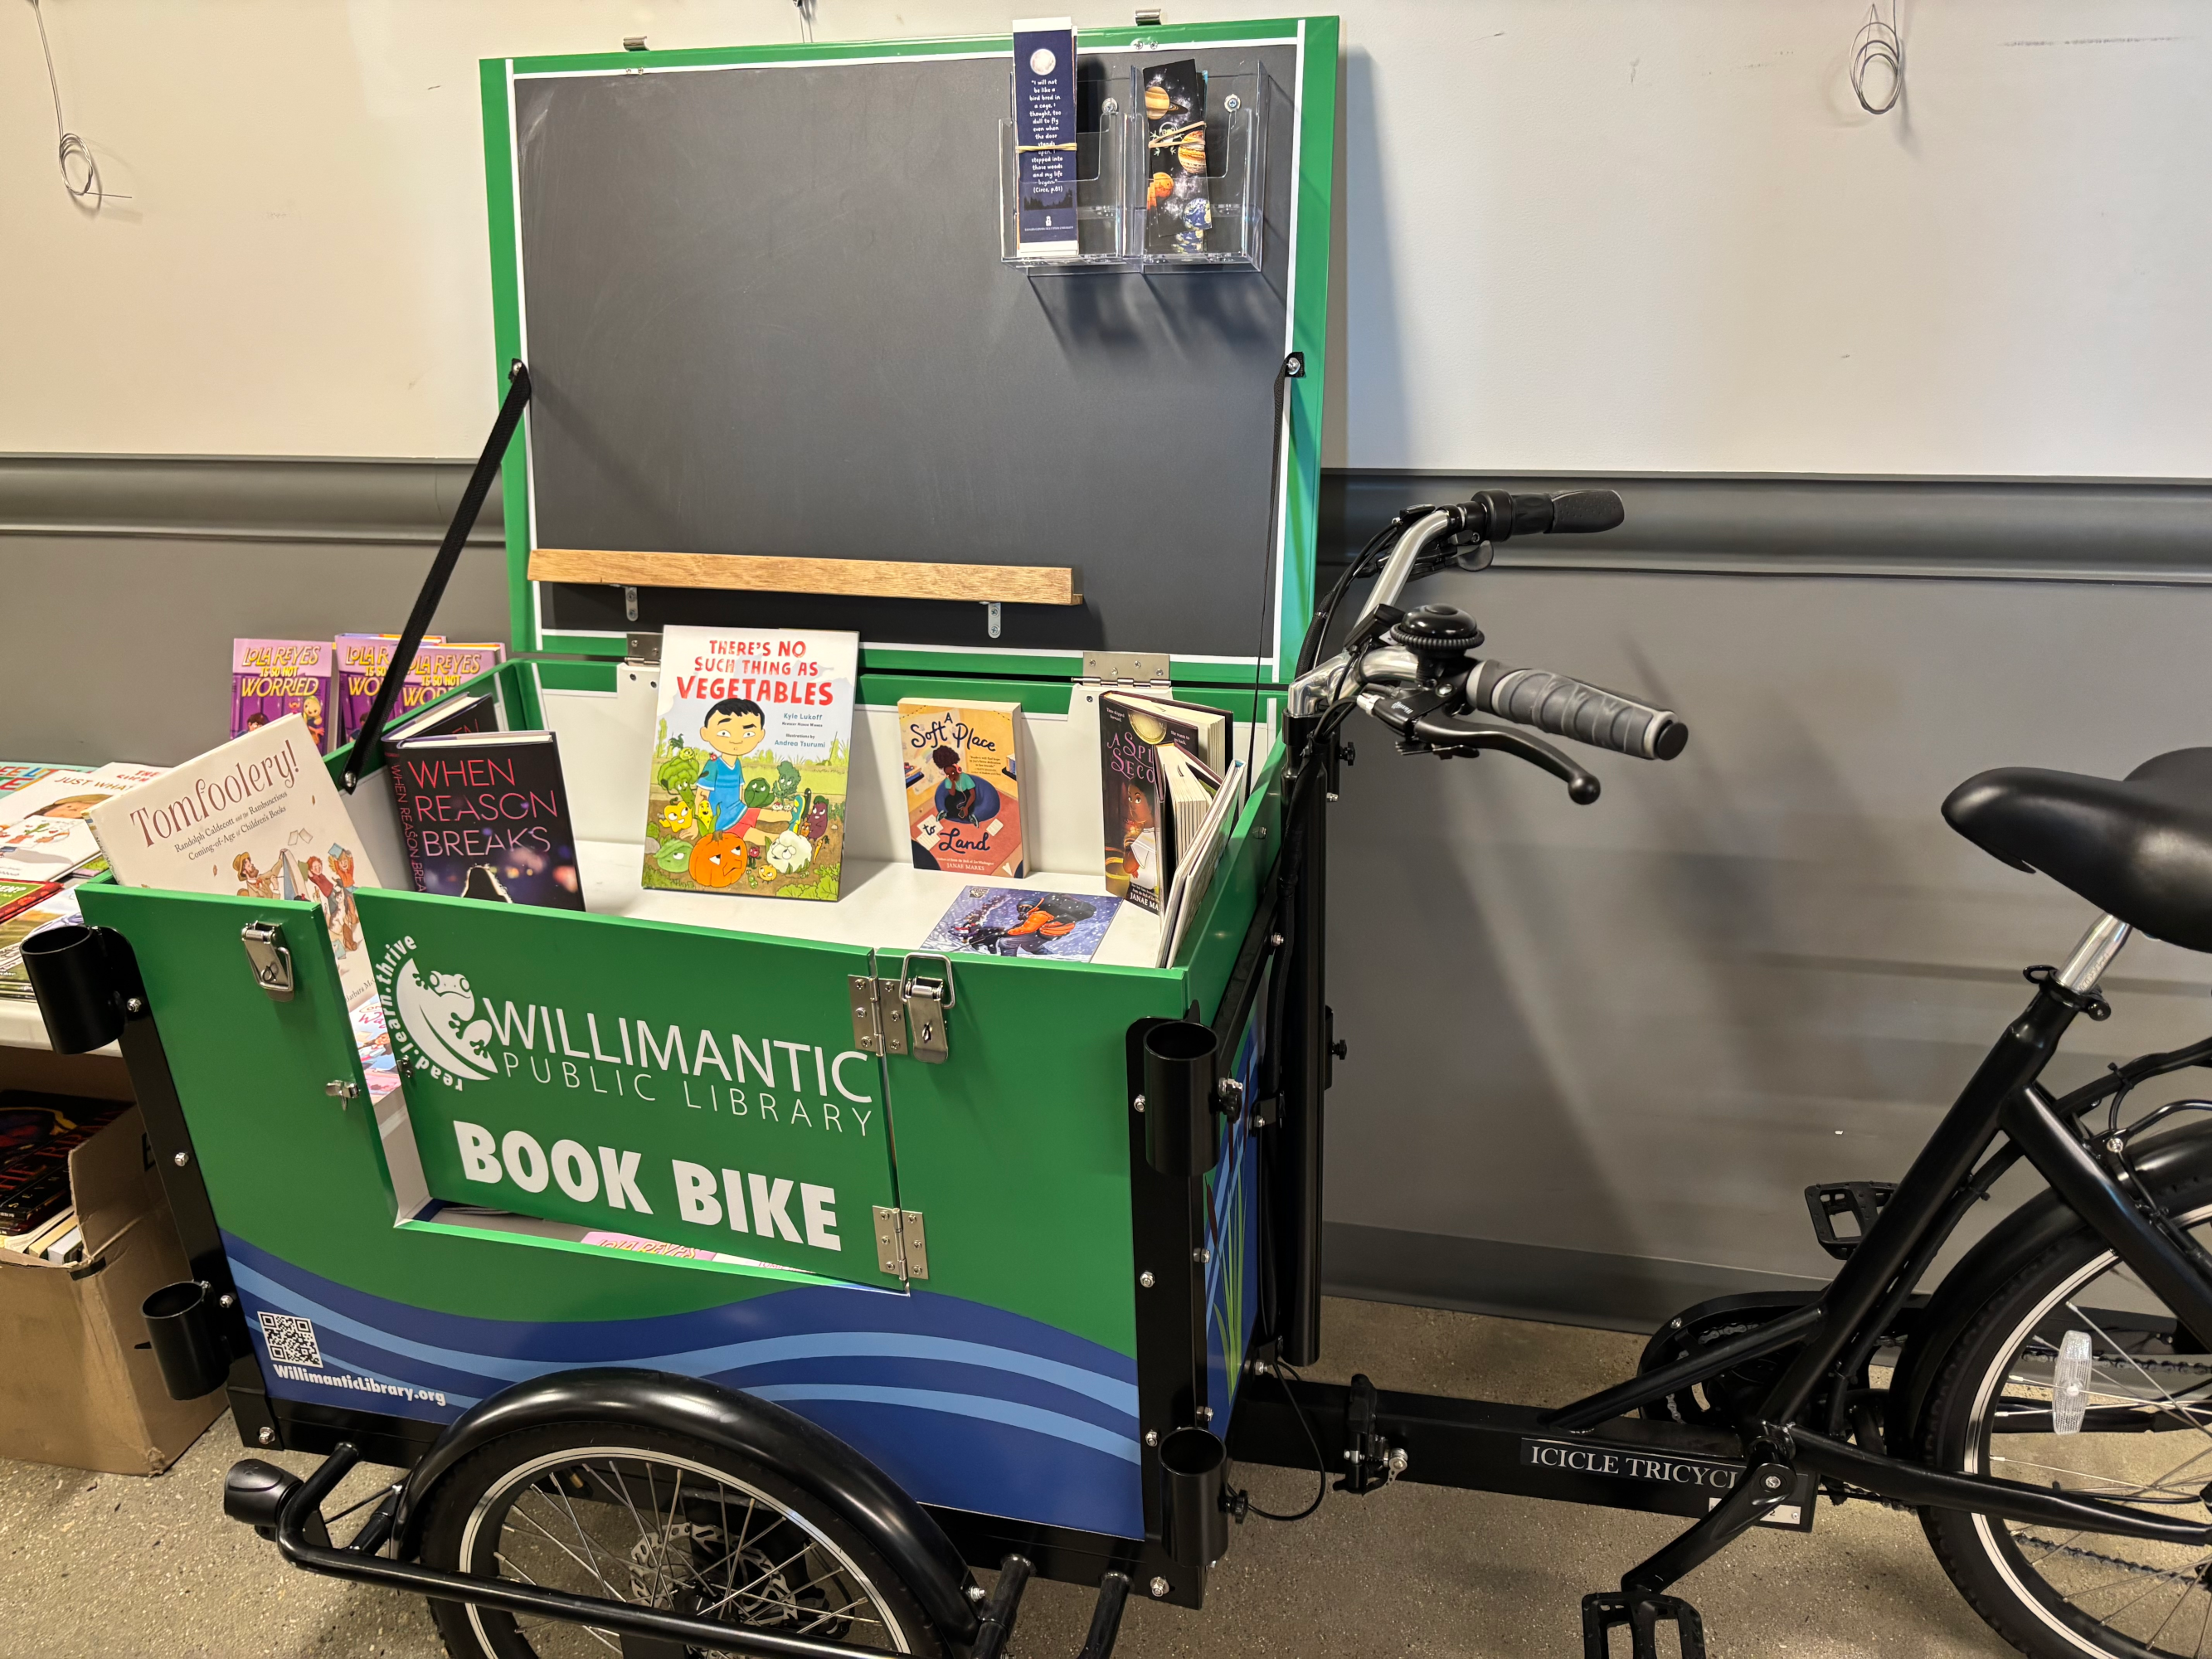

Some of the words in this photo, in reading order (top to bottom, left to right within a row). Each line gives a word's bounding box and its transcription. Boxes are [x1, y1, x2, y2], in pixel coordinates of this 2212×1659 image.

[1051, 117, 1059, 125] fly
[242, 647, 273, 667] LOLA
[273, 645, 322, 666] REYES
[346, 645, 375, 665] LOLA
[433, 654, 481, 674] REYES
[709, 640, 771, 657] THERE'S
[779, 641, 806, 658] NO
[260, 666, 268, 677] IS
[270, 667, 280, 678] SO
[281, 667, 299, 678] NOT
[365, 665, 374, 677] IS
[421, 674, 430, 687] IS
[432, 675, 443, 687] SO
[444, 675, 461, 687] NOT
[695, 656, 735, 673] SUCH
[742, 659, 791, 675] THING
[798, 661, 819, 677] AS
[241, 677, 319, 698] WORRIED
[676, 675, 834, 706] VEGETABLES
[944, 713, 953, 723] A
[910, 721, 948, 749] Soft
[952, 722, 996, 752] Place
[1106, 732, 1121, 749] A
[407, 758, 515, 789] WHEN
[1111, 747, 1155, 783] SECO
[129, 739, 299, 848] Tomfoolery!
[416, 790, 558, 822] REASON
[174, 833, 206, 853] Randolph
[205, 818, 235, 837] Caldecott
[248, 791, 288, 815] Rambunctious
[188, 832, 236, 860] Coming-of-Age
[241, 814, 270, 834] Children's
[269, 805, 287, 819] Books
[391, 764, 408, 803] WHEN
[400, 807, 420, 859] REASON
[411, 862, 427, 893] BREA
[422, 826, 551, 857] BREAKS
[922, 823, 936, 836] to
[939, 828, 991, 854] Land
[483, 997, 873, 1103] WILLIMANTIC
[503, 1051, 656, 1102] PUBLIC
[683, 1085, 873, 1136] LIBRARY
[453, 1120, 654, 1215] BOOK
[671, 1158, 841, 1251] BIKE
[272, 1365, 447, 1407] WillimanticLibrary.org
[1531, 1445, 1619, 1475] ICICLE
[1626, 1457, 1738, 1490] TRICYCL
